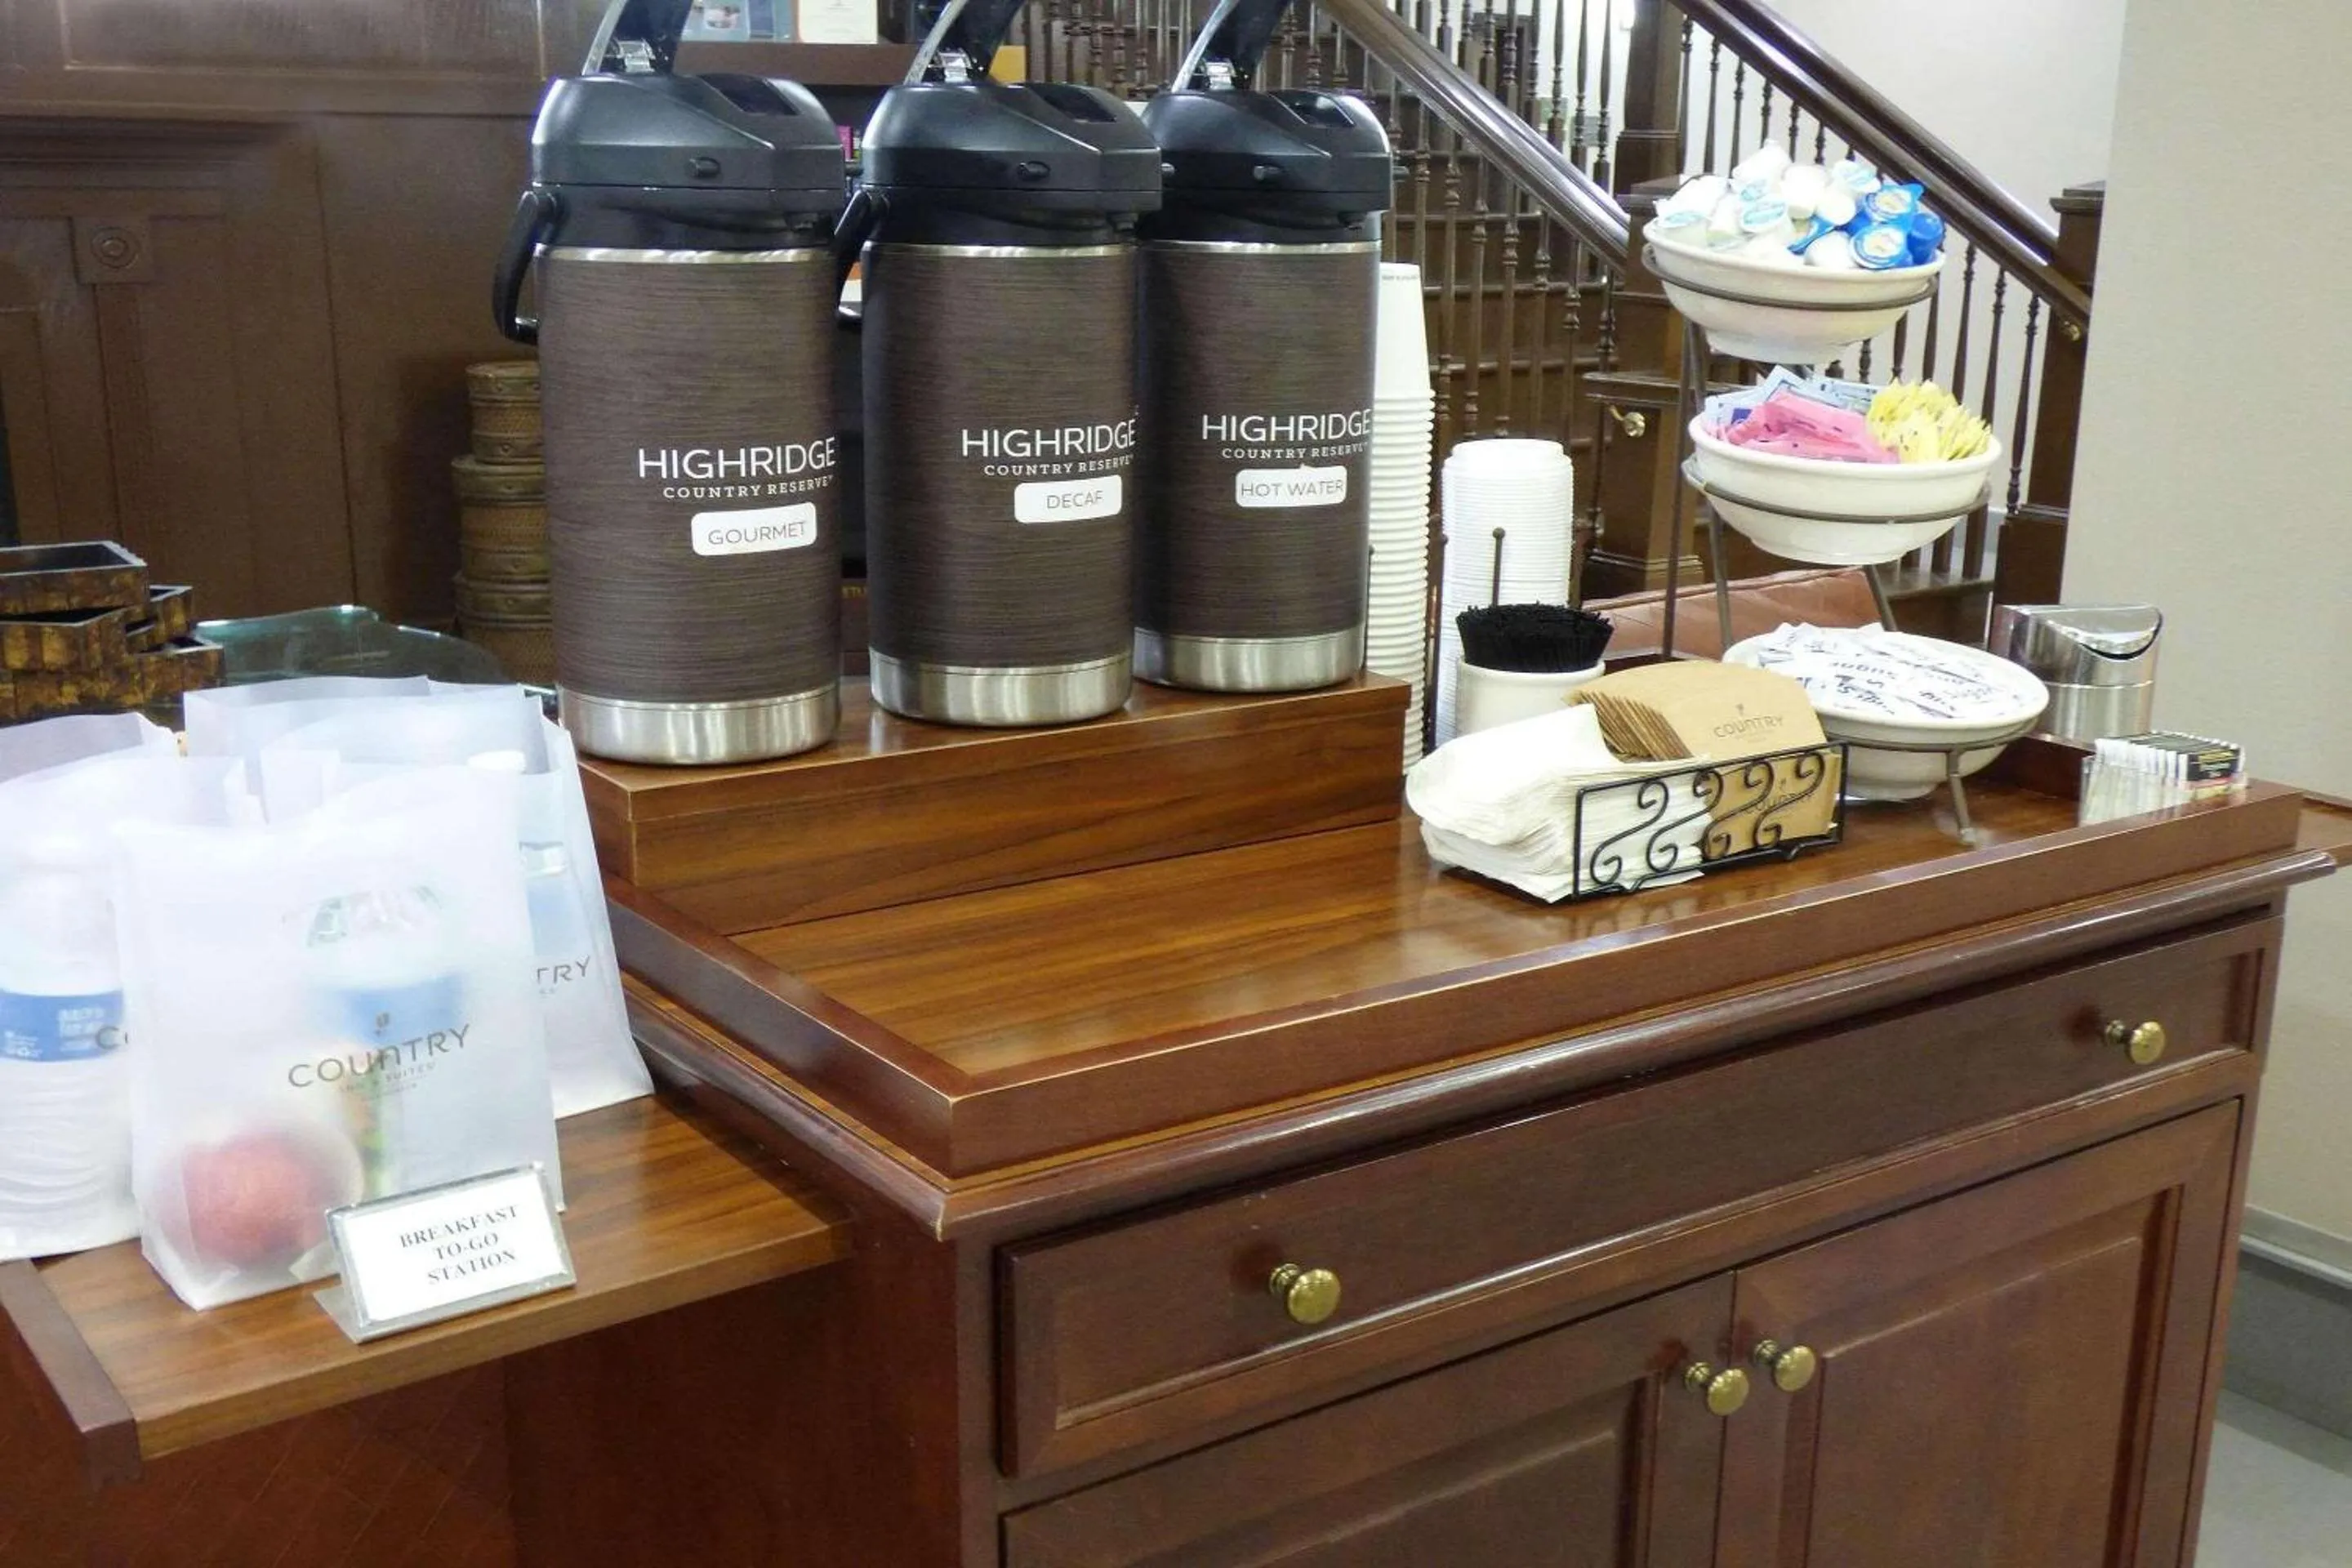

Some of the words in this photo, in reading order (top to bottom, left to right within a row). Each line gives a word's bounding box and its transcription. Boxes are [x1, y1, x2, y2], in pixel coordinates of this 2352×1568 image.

[961, 418, 1136, 457] HIGHRIDGE
[1202, 408, 1372, 442] HIGHRIDGE
[638, 437, 836, 479] HIGHRIDGE
[983, 462, 1074, 476] COUNTRY
[1078, 454, 1131, 473] RESERVE
[1222, 448, 1307, 460] COUNTRY
[662, 484, 761, 499] COUNTRY
[767, 475, 830, 495] RESERVE
[1046, 490, 1104, 510] DECAF
[1241, 483, 1282, 497] HOT
[1287, 479, 1344, 497] WATER
[707, 521, 807, 546] GOURMET
[1713, 715, 1784, 737] COUNTRY
[287, 1023, 470, 1088] COUNTRY
[399, 1204, 519, 1249] BREAKFAST
[434, 1232, 500, 1260] TO-GO
[427, 1249, 517, 1285] STATION
